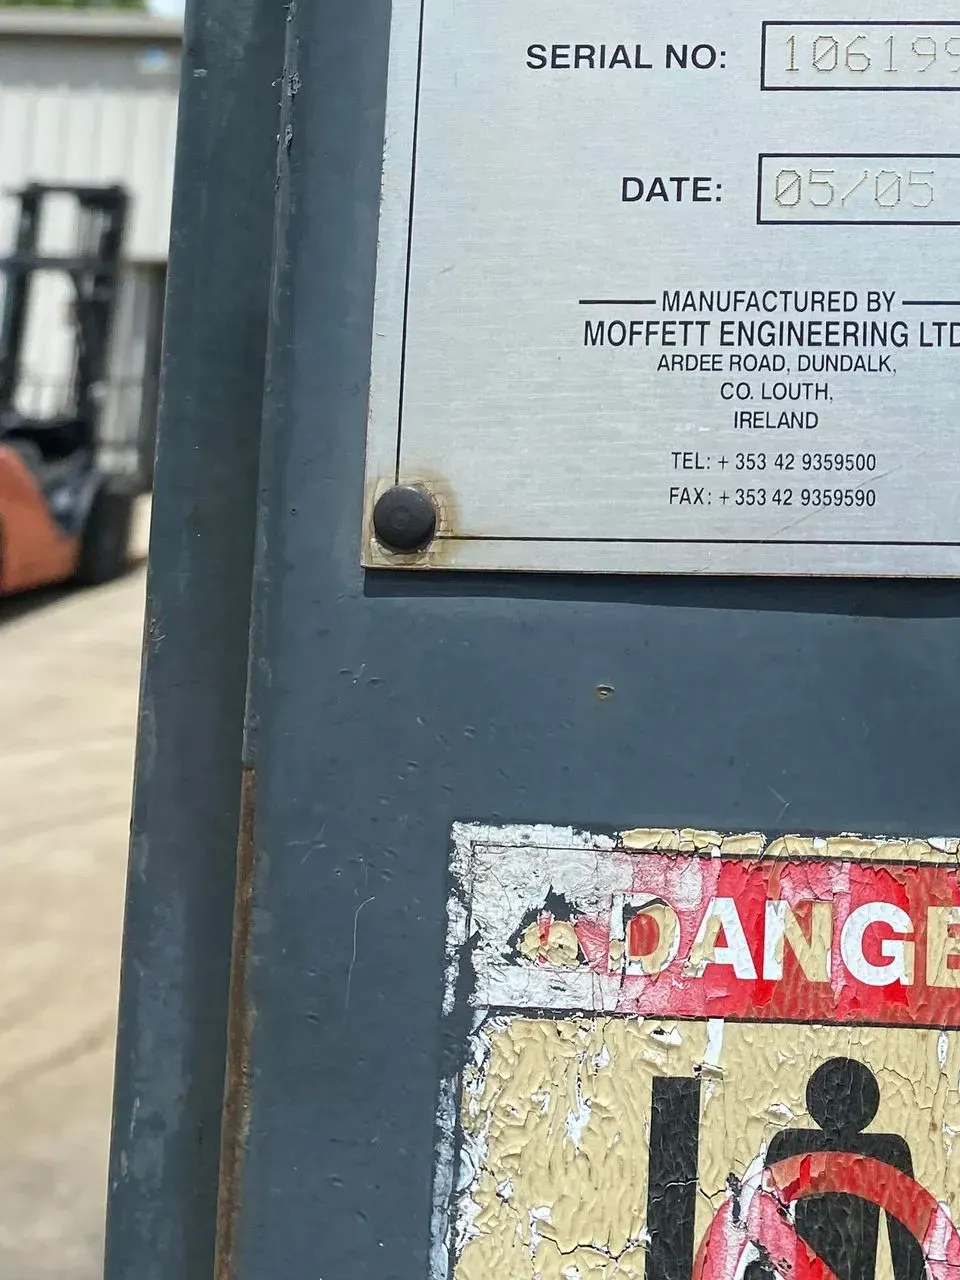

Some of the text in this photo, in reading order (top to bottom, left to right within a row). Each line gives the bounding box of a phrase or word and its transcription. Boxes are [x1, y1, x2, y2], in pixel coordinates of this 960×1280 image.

[526, 43, 727, 70] SERIAL NO:
[621, 176, 722, 202] DATE:
[774, 169, 935, 208] 05/05
[662, 290, 896, 313] MANUFACTURED BY
[583, 320, 711, 347] MOFFETT
[719, 320, 909, 348] ENGINEERING
[656, 354, 897, 377] ARDEE ROAD, DUNDALK,
[720, 382, 834, 405] CO. LOUTH,
[734, 410, 820, 430] IRELAND
[671, 452, 712, 471] TEL:
[735, 453, 767, 471] 353
[774, 453, 795, 471] 42
[802, 453, 877, 472] 9359500
[669, 487, 713, 506] FAX:
[735, 488, 767, 506] 353
[771, 488, 793, 506] 42
[800, 488, 877, 507] 9359590
